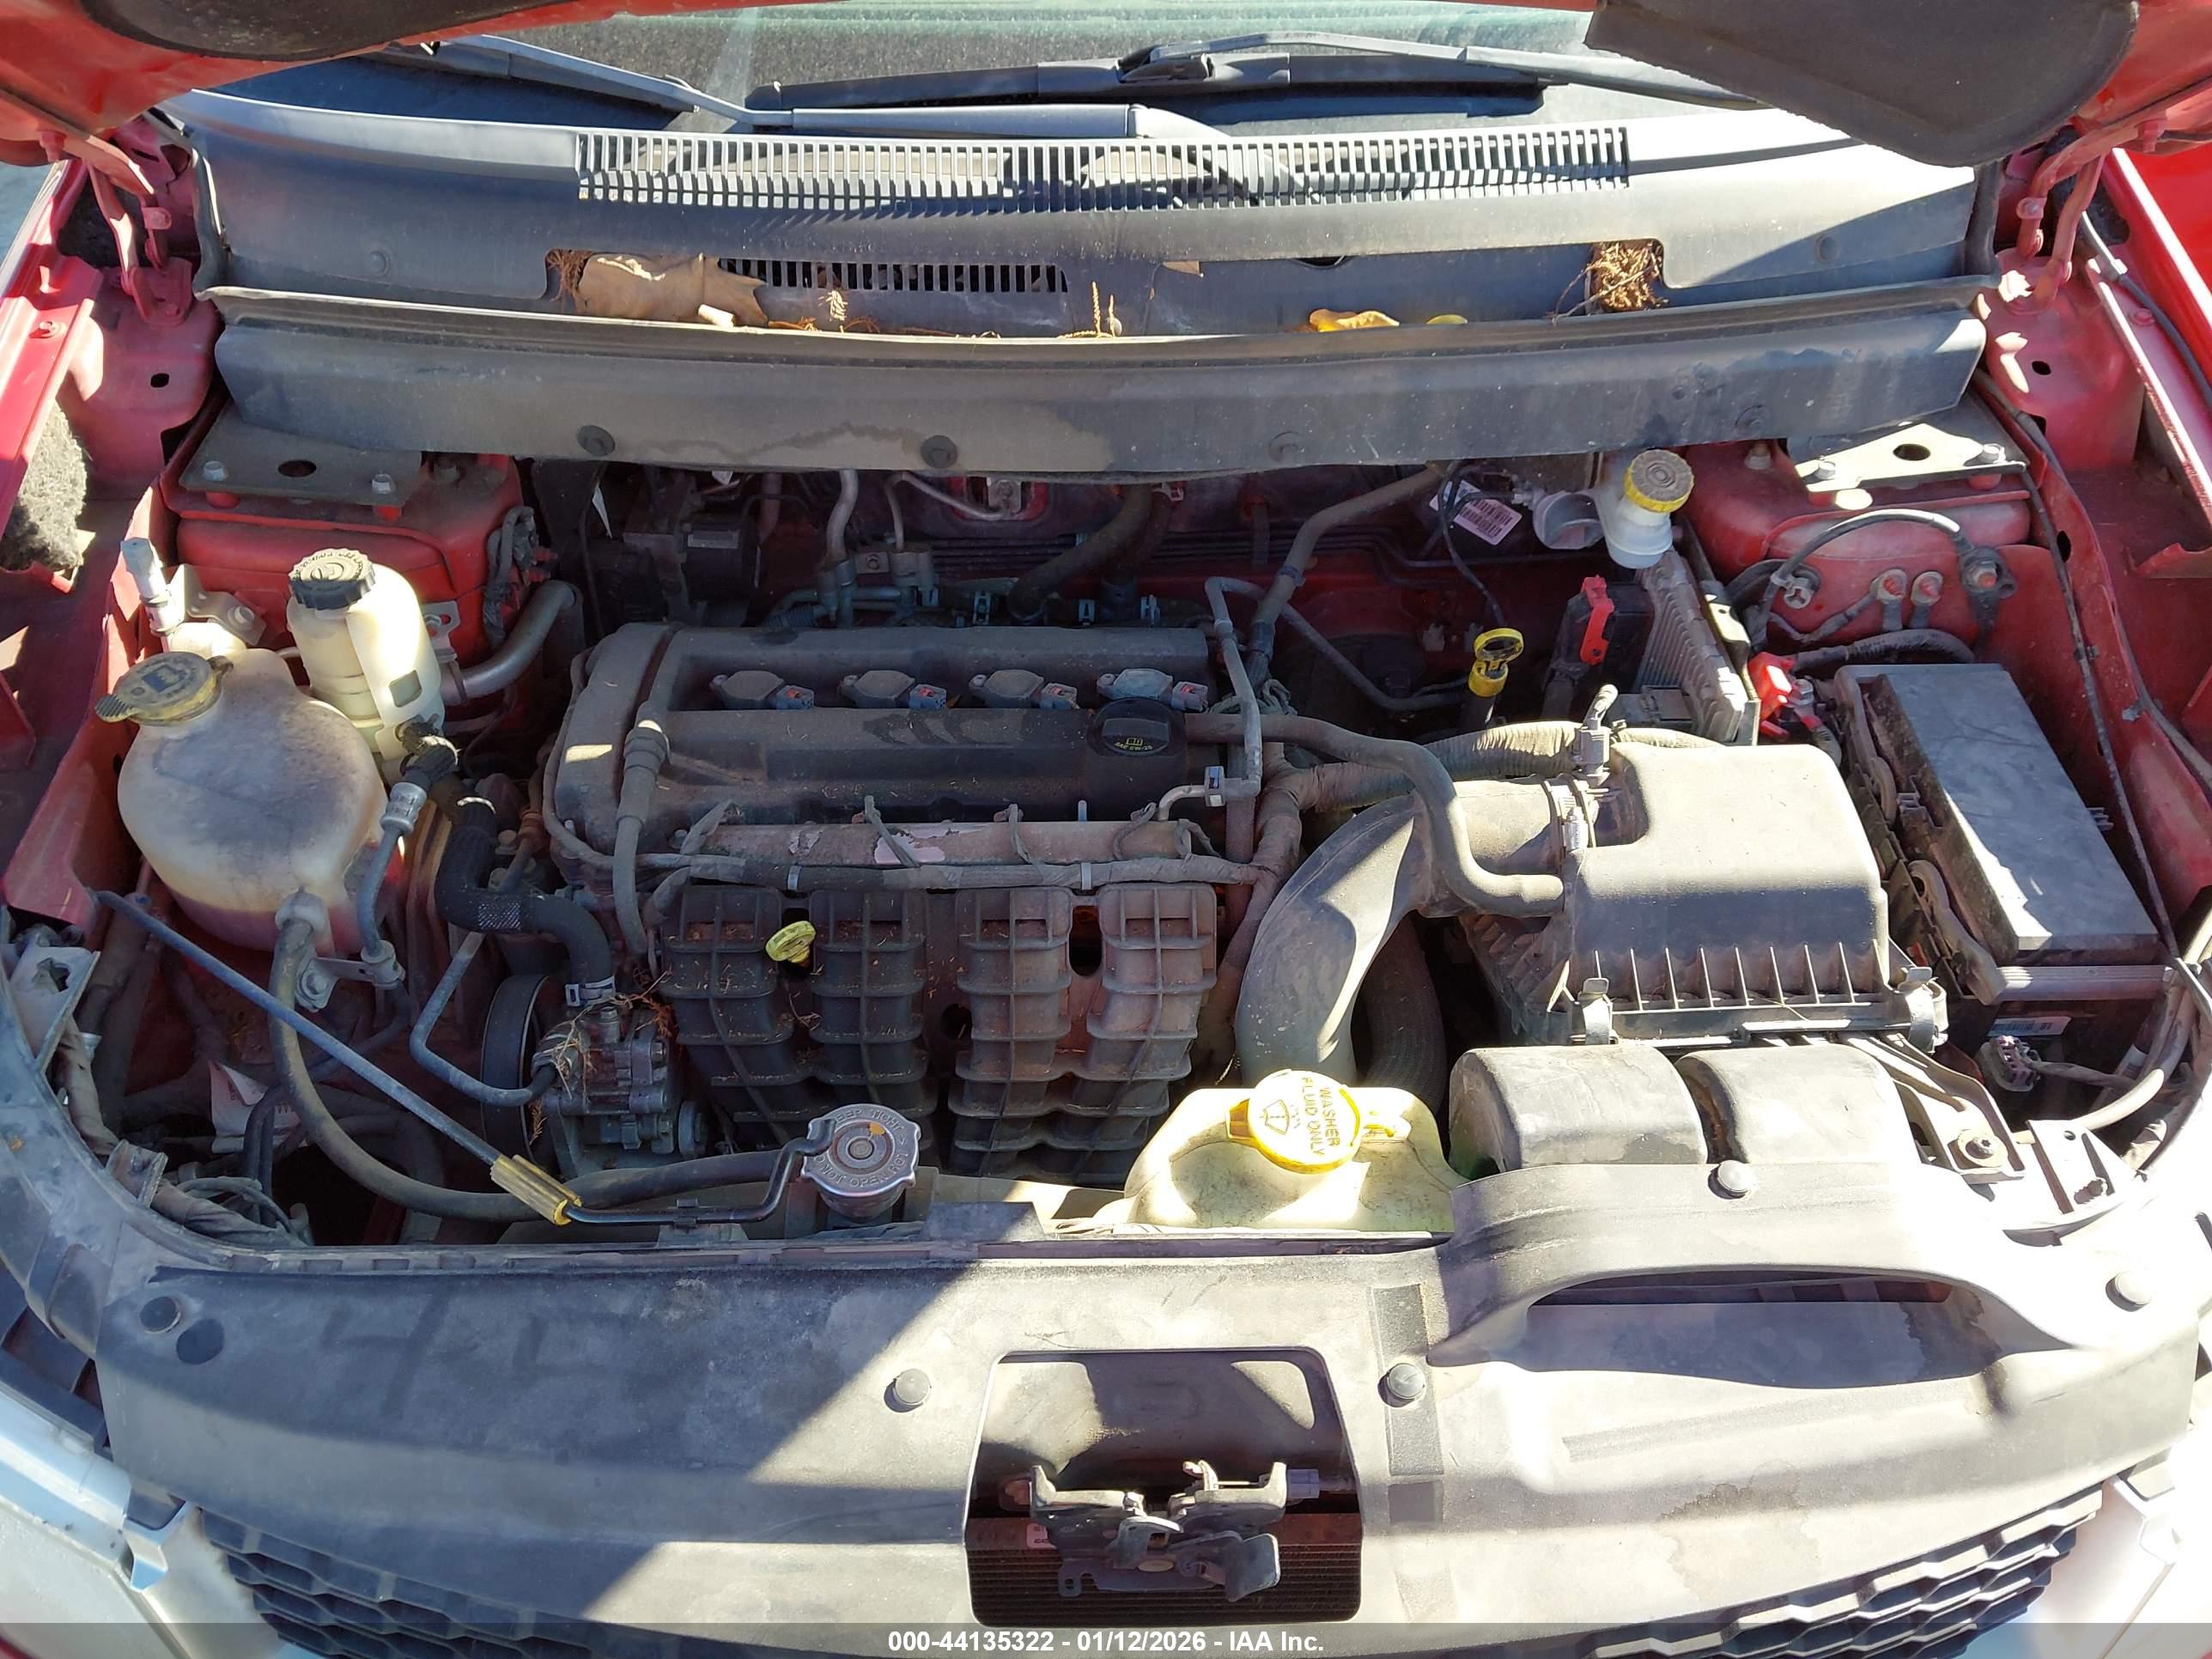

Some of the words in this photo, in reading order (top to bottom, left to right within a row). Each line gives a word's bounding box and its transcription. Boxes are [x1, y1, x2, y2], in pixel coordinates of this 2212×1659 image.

[1302, 1077, 1318, 1116] FLUID
[836, 1109, 862, 1122] EEP
[1319, 1087, 1340, 1147] WASHER
[1307, 1120, 1325, 1157] ONLY
[821, 1162, 847, 1182] NOT
[849, 1170, 888, 1187] OPEN
[888, 1152, 908, 1174] HOT
